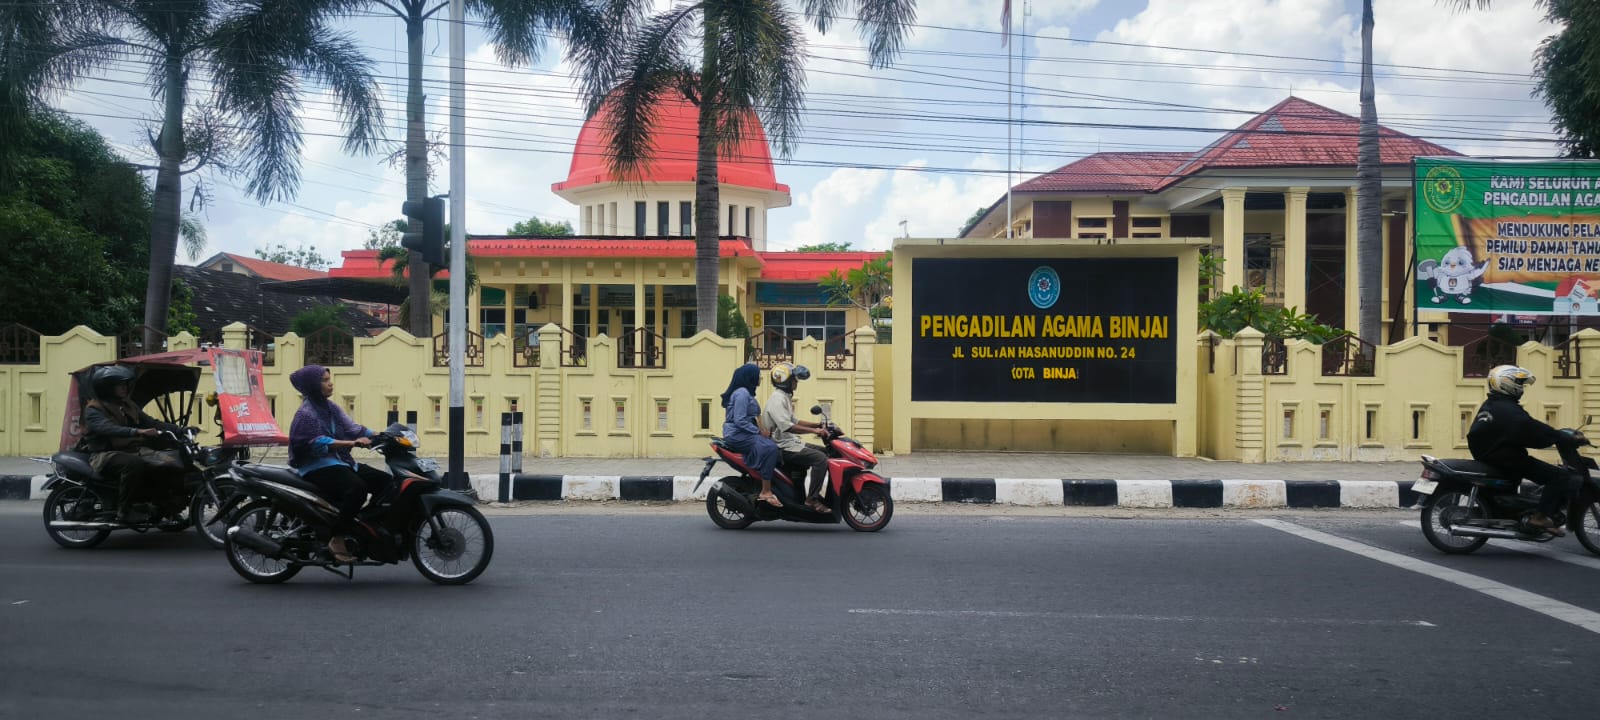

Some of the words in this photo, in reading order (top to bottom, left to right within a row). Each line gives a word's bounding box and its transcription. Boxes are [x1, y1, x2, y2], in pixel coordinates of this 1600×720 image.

[1490, 176, 1525, 189] KAMI
[1528, 177, 1591, 190] SELURUH
[1483, 191, 1571, 206] PENGADILAN
[1574, 193, 1600, 206] AGA
[1497, 222, 1570, 237] MENDUKUNG
[1486, 240, 1527, 254] PEMILU
[1530, 241, 1569, 255] DAMAI
[1498, 258, 1524, 271] SIAP
[1526, 258, 1582, 272] MENJAGA
[920, 314, 1036, 338] PENGADILAN
[1041, 314, 1104, 338] AGAMA
[1109, 315, 1168, 339] BINJAI
[951, 346, 965, 359] JL
[1018, 346, 1095, 359] HASANUDDIN
[1097, 346, 1118, 359] NO.
[1120, 346, 1136, 359] 24
[1042, 367, 1080, 380] BINJA
